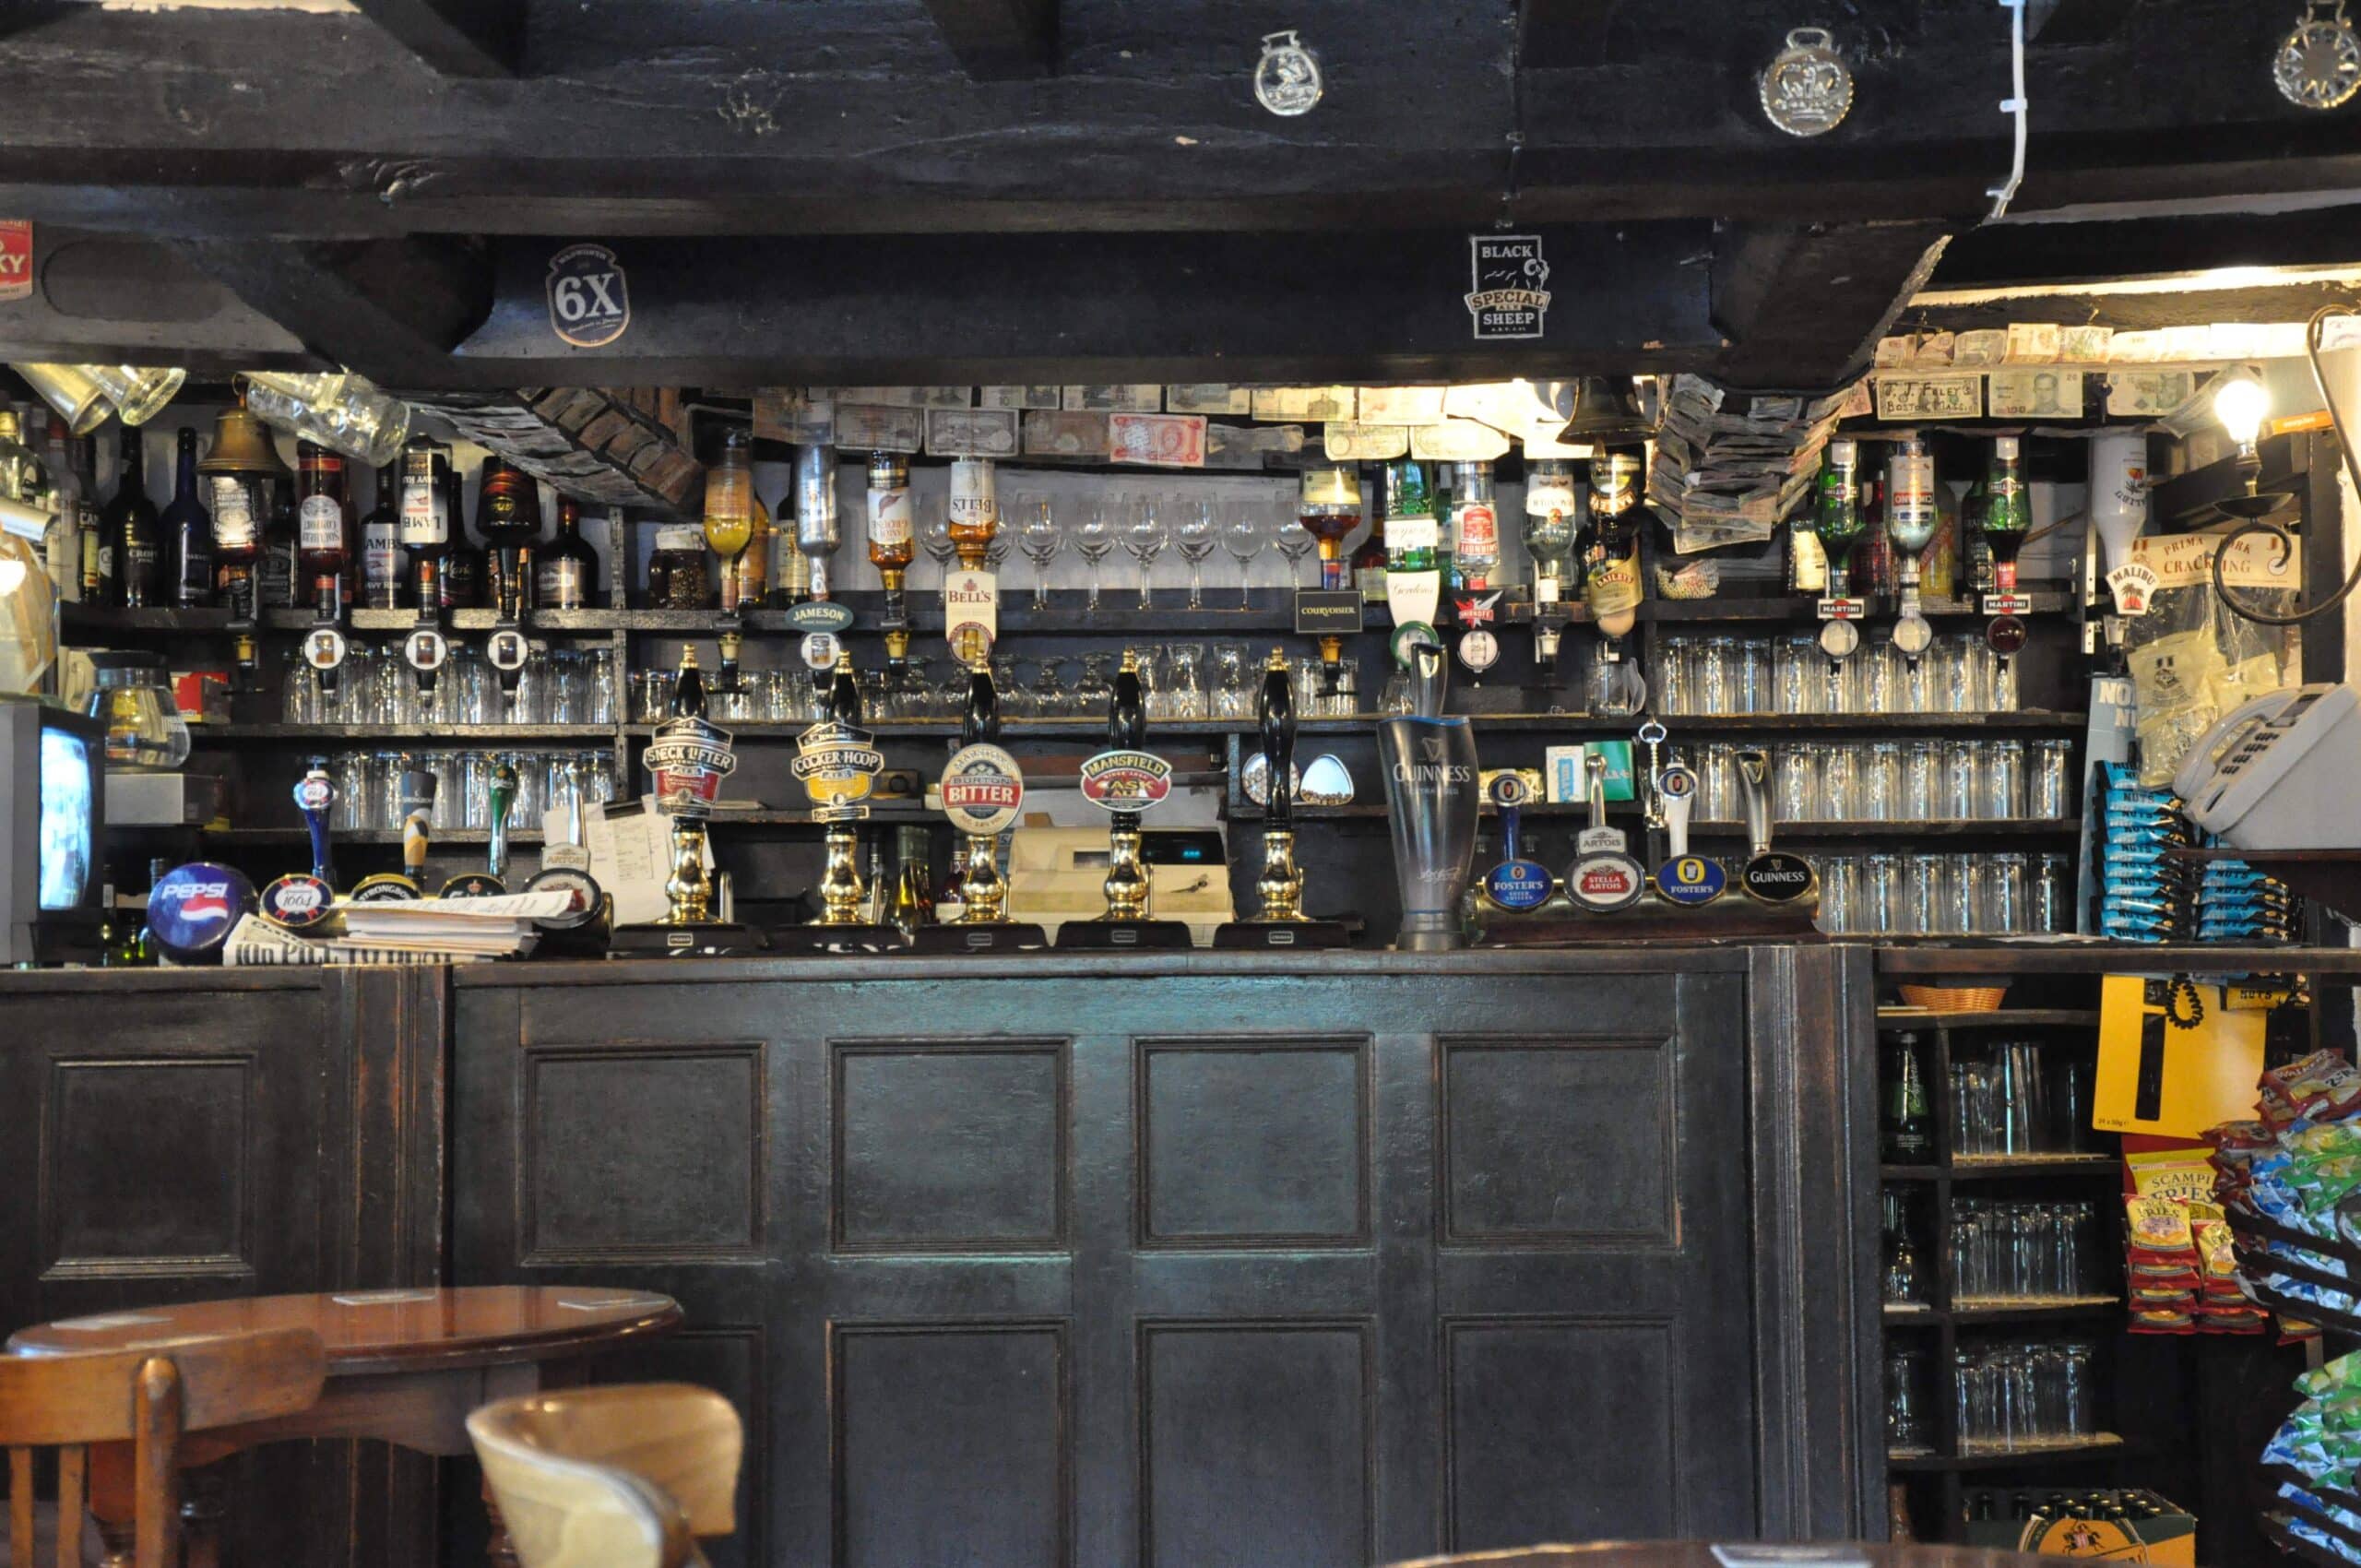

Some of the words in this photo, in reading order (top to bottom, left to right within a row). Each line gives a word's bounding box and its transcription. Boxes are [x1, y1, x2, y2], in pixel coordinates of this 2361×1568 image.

[1481, 245, 1534, 258] BLACK
[555, 273, 623, 321] 6X
[1472, 291, 1545, 308] SPECIAL
[1483, 313, 1536, 326] SHEEP
[1887, 400, 1929, 412] BOSTON
[1825, 488, 1858, 496] MARTINI
[953, 499, 992, 514] BELL'S
[2164, 536, 2204, 554] PRIMA
[2164, 554, 2251, 574] CRACKING
[1596, 574, 1634, 588] BAILEYS
[2112, 565, 2156, 586] MALIBU
[949, 590, 991, 603] BELL'S
[1301, 606, 1357, 616] COURVOISIER
[1822, 604, 1860, 612] MARTINI
[1988, 600, 2027, 609] MARTINI
[793, 608, 846, 623] JAMESON
[1459, 609, 1494, 620] SMIRNOFF
[647, 746, 685, 762] SNECK
[688, 746, 731, 769] LIFTER
[796, 752, 841, 773] COCKER
[844, 752, 879, 767] HOOP
[1088, 755, 1164, 776] MANSFIELD
[1393, 763, 1471, 783] GUINNESS
[954, 777, 1012, 785] BURTON
[948, 786, 1014, 802] BITTER
[2124, 792, 2154, 803] NUTS
[1584, 837, 1621, 848] ARTOIS
[546, 855, 585, 865] ARTOIS
[1750, 871, 1806, 884] GUINNESS
[2216, 870, 2248, 879] NUTS
[161, 883, 230, 899] PEPSI
[1494, 881, 1544, 891] FOSTER'S
[1670, 885, 1714, 894] FOSTER'S
[358, 885, 412, 901] STRONGBO
[282, 892, 313, 909] 1664
[2240, 988, 2272, 1000] NUTS
[2152, 1173, 2211, 1188] SCAMPI
